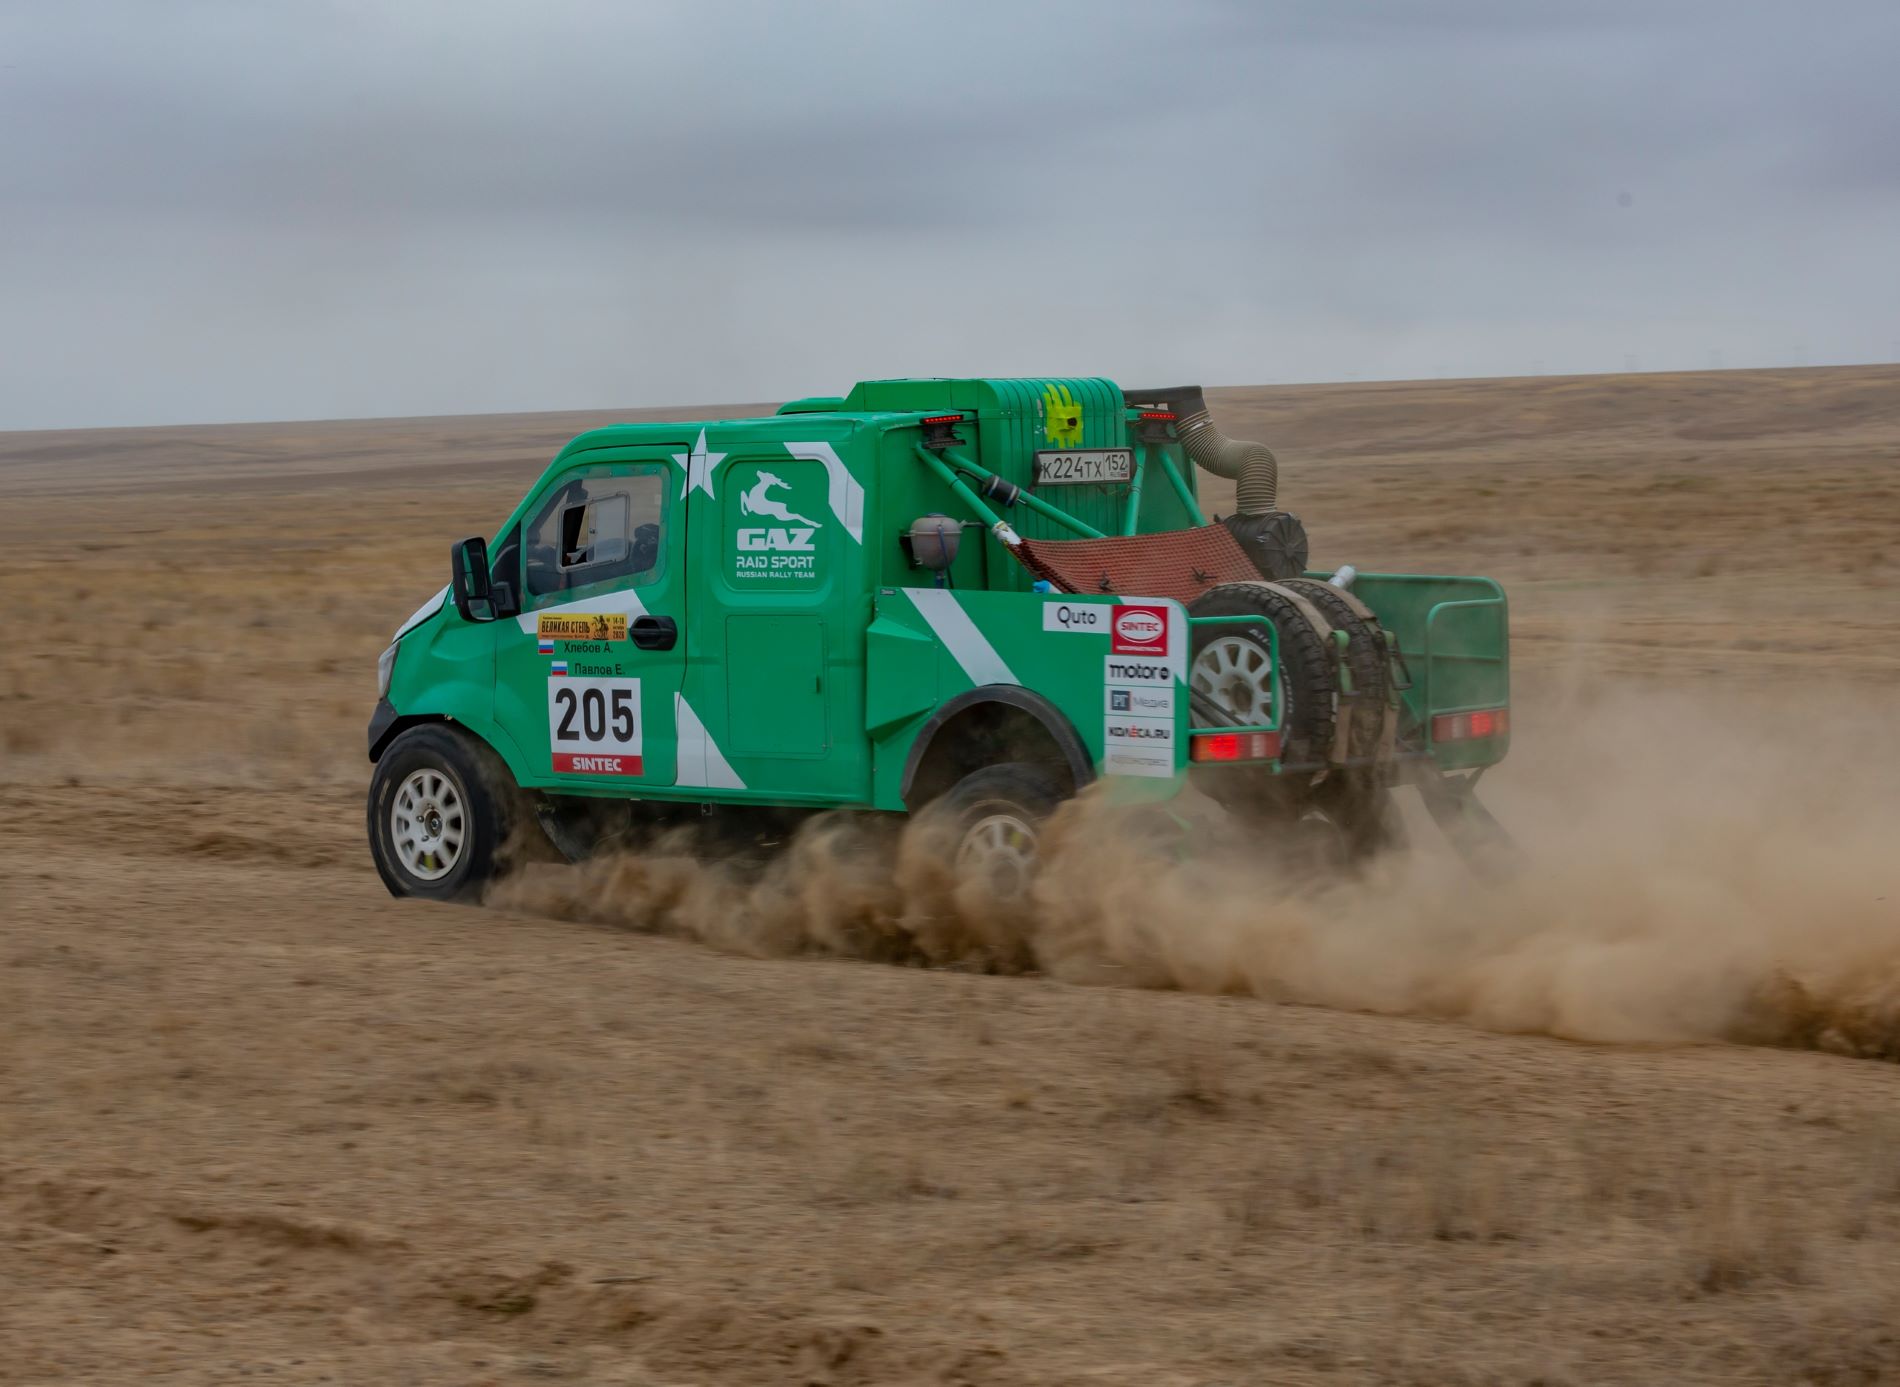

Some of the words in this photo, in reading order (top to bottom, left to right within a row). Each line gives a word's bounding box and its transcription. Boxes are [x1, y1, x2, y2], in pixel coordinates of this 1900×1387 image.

[1105, 454, 1126, 471] 152
[737, 528, 815, 551] GAZ
[736, 556, 768, 568] RAID
[771, 556, 815, 568] SPORT
[1057, 606, 1097, 628] Quto
[541, 620, 570, 633] ВЕЛИКАЯ
[571, 621, 590, 633] СТЕПЬ
[1121, 621, 1159, 632] SINTEC
[564, 642, 600, 653] Хлебов
[604, 642, 614, 653] А.
[575, 663, 612, 675] Павлов
[615, 664, 625, 675] Е.
[555, 688, 634, 742] 205
[572, 757, 622, 772] SINTEC
